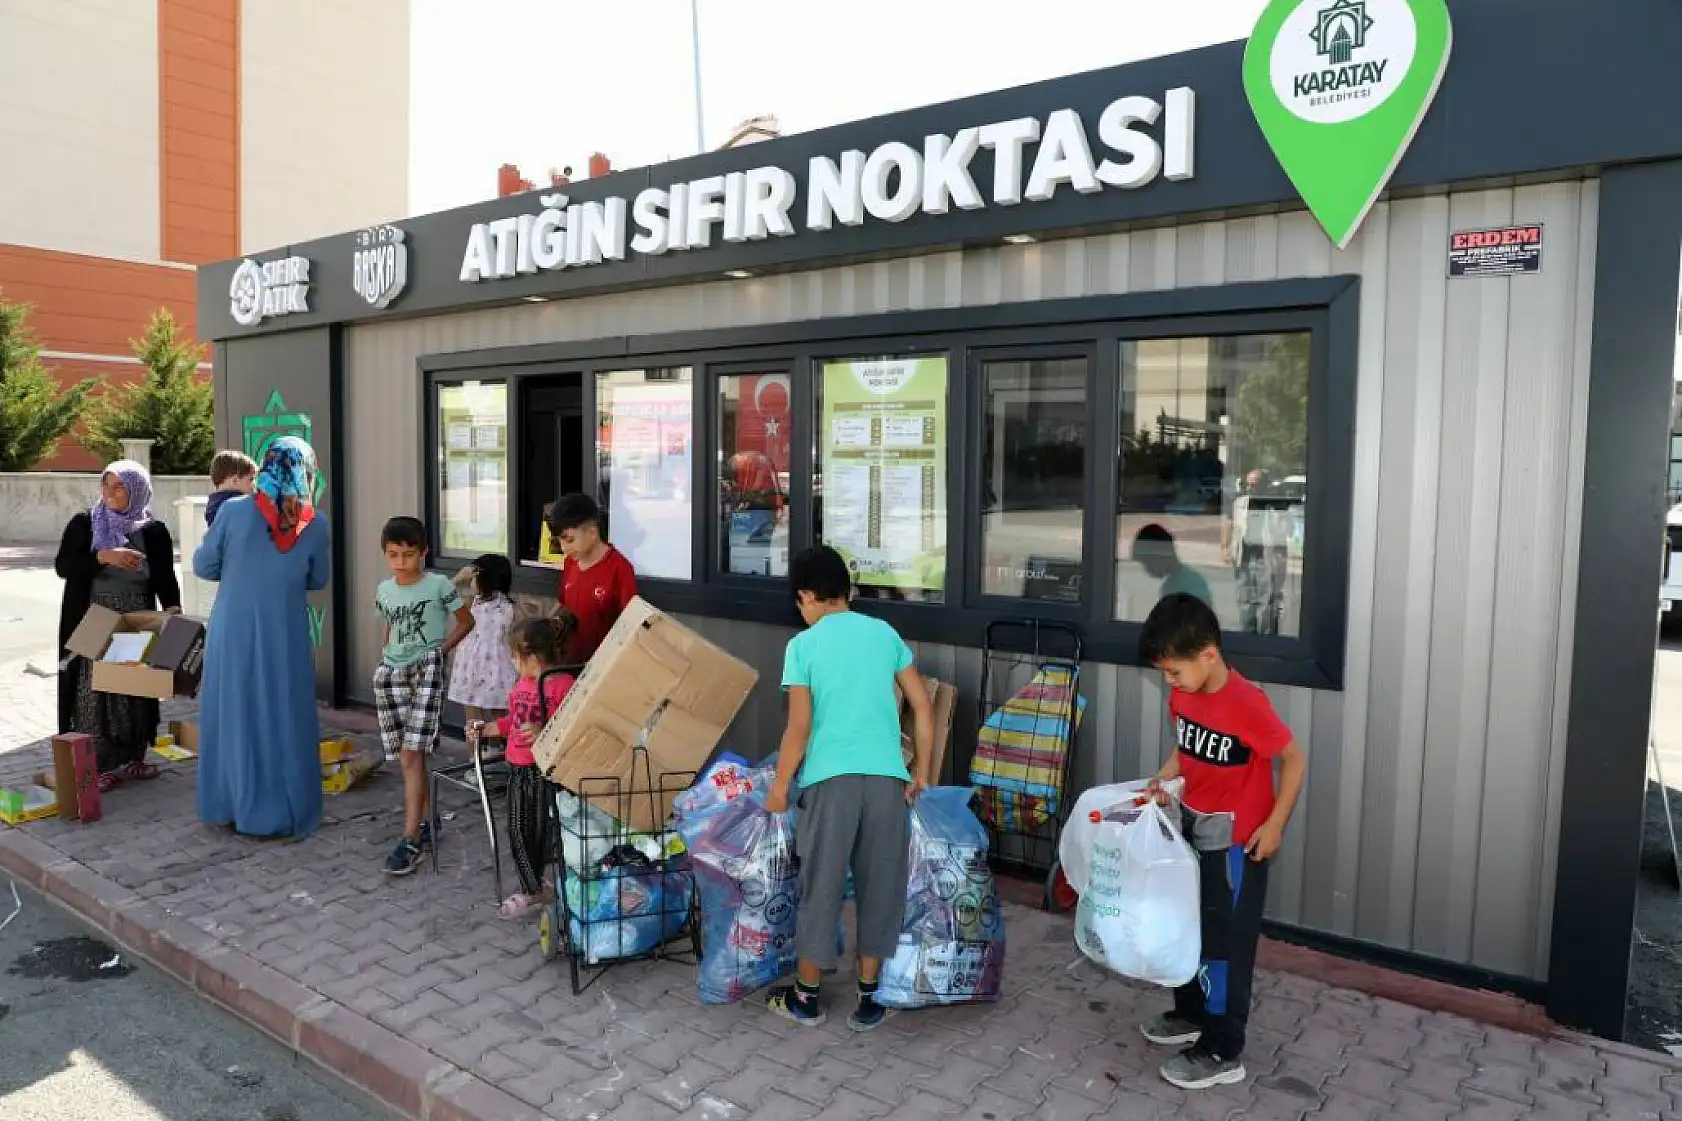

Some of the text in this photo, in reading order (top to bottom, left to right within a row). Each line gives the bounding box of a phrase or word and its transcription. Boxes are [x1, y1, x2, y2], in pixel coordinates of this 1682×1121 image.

[1293, 59, 1388, 98] KARATAY
[1310, 89, 1371, 107] BELEDİYESİ
[459, 86, 1196, 282] ATIĞIN SIFIR NOKTASI
[1453, 229, 1538, 249] ERDEM
